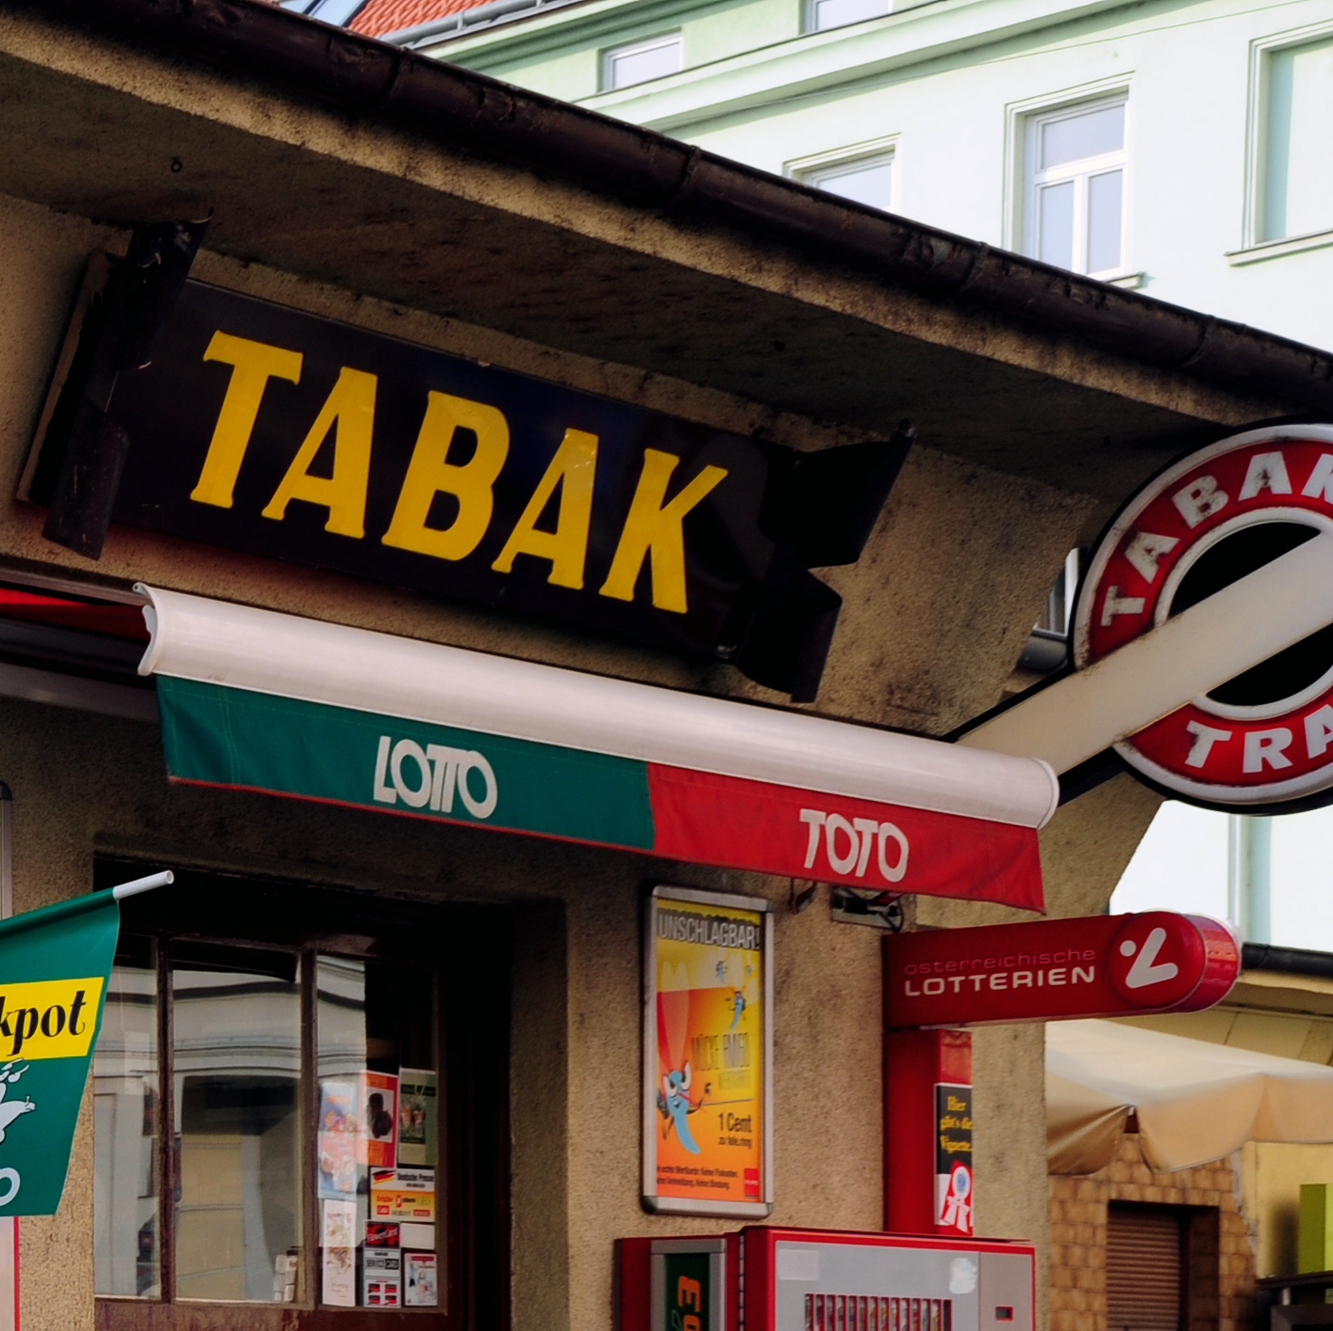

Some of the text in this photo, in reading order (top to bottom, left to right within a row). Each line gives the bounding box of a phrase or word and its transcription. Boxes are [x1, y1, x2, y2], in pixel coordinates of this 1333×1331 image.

[190, 330, 729, 614] TABAK
[372, 735, 498, 820] LOTTO
[799, 809, 910, 884] TOTO
[658, 914, 760, 950] UNSCHLAGBAR!
[904, 946, 1097, 976] österreichische
[904, 965, 1097, 998] LOTTERIEN
